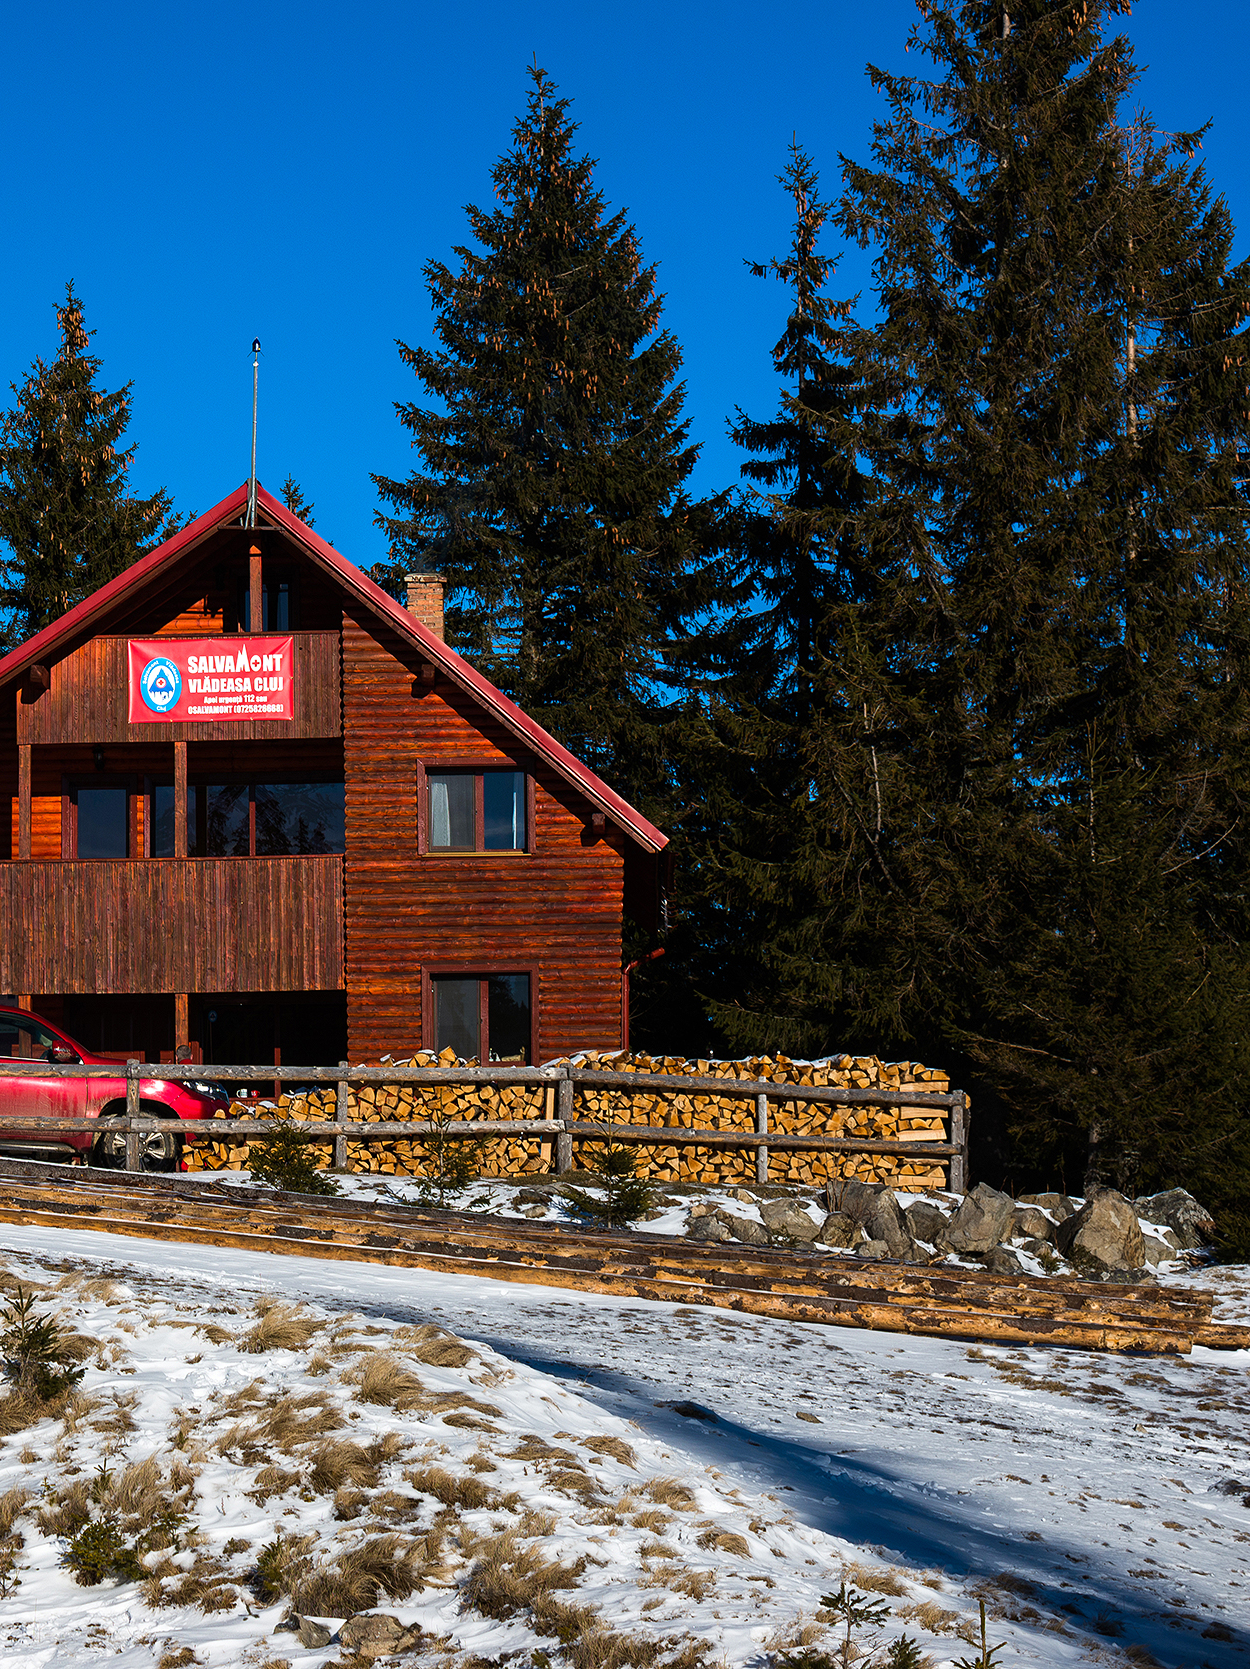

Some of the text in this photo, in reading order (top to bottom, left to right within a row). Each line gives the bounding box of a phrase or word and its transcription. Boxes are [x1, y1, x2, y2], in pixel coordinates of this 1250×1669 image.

[187, 643, 283, 674] SALVAMONT
[188, 676, 284, 693] VLĂDEASA CLUJ
[203, 696, 218, 704] Apel
[243, 694, 255, 703] 112
